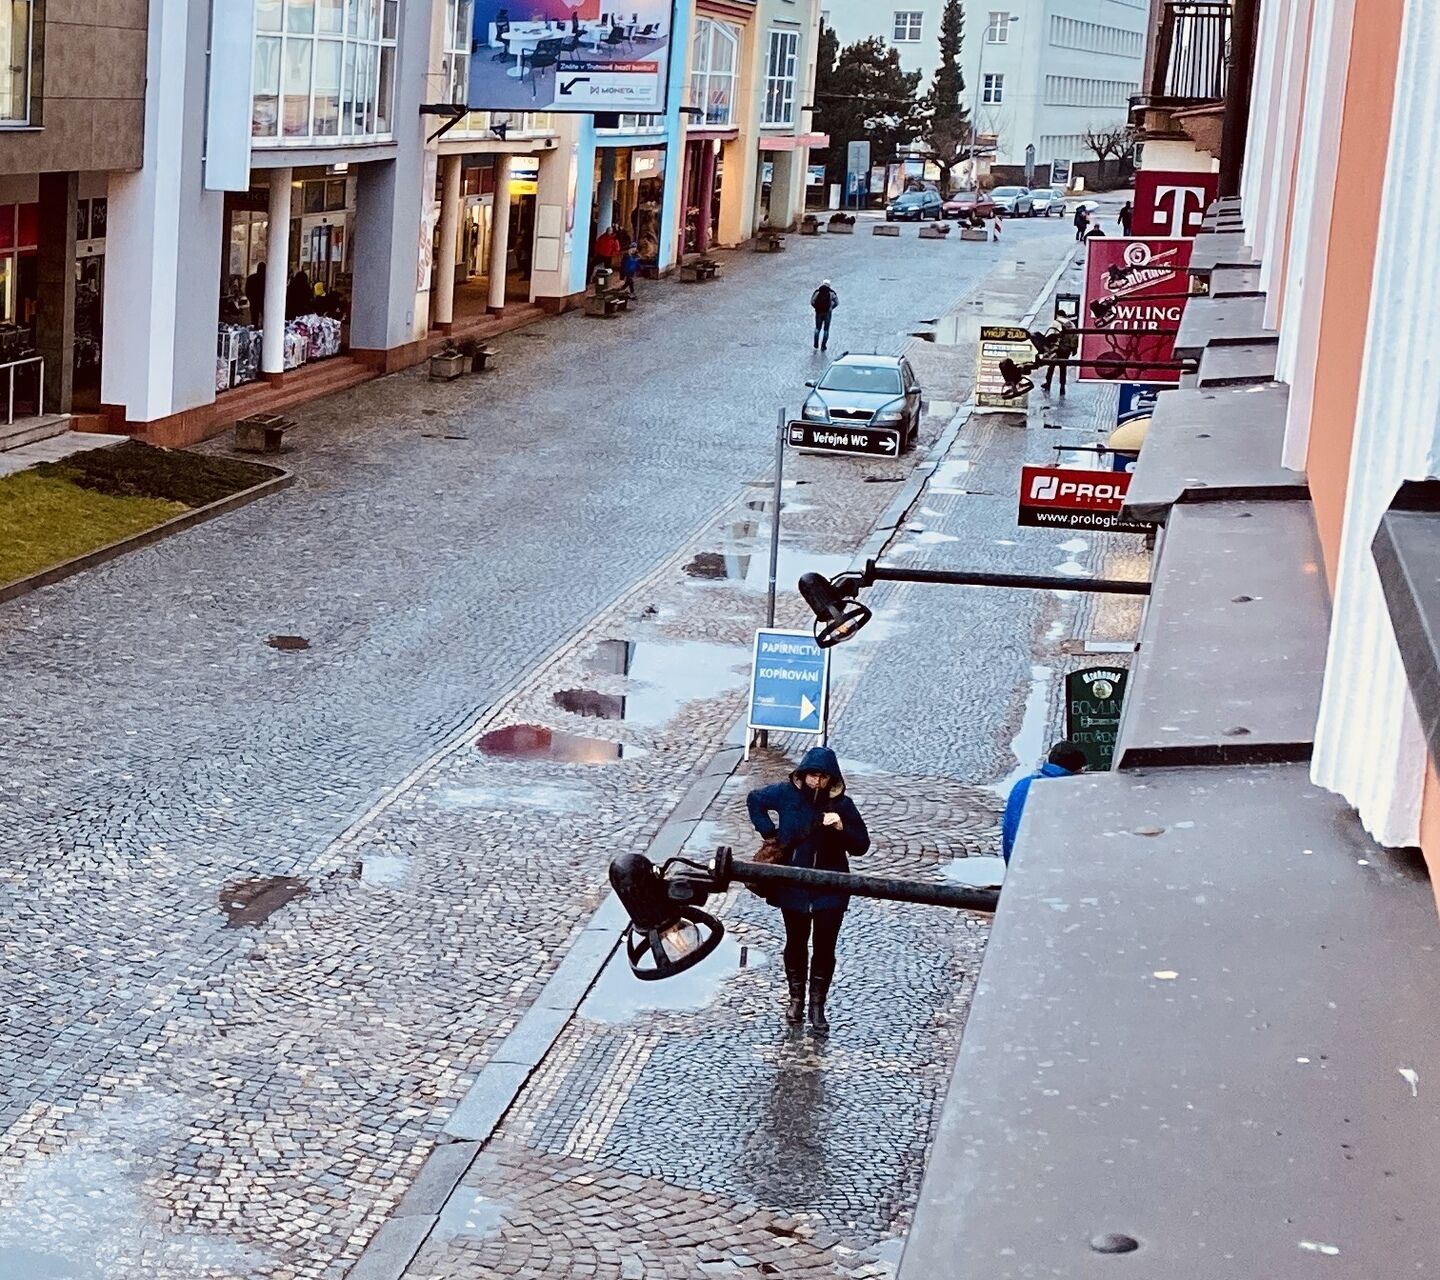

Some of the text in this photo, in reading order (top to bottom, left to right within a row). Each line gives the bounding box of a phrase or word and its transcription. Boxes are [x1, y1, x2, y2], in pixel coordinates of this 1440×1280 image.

[1091, 305, 1181, 320] WLING
[813, 431, 848, 446] Veřejné
[851, 434, 869, 447] WC
[760, 667, 819, 682] KOPÍROVÁNÍ
